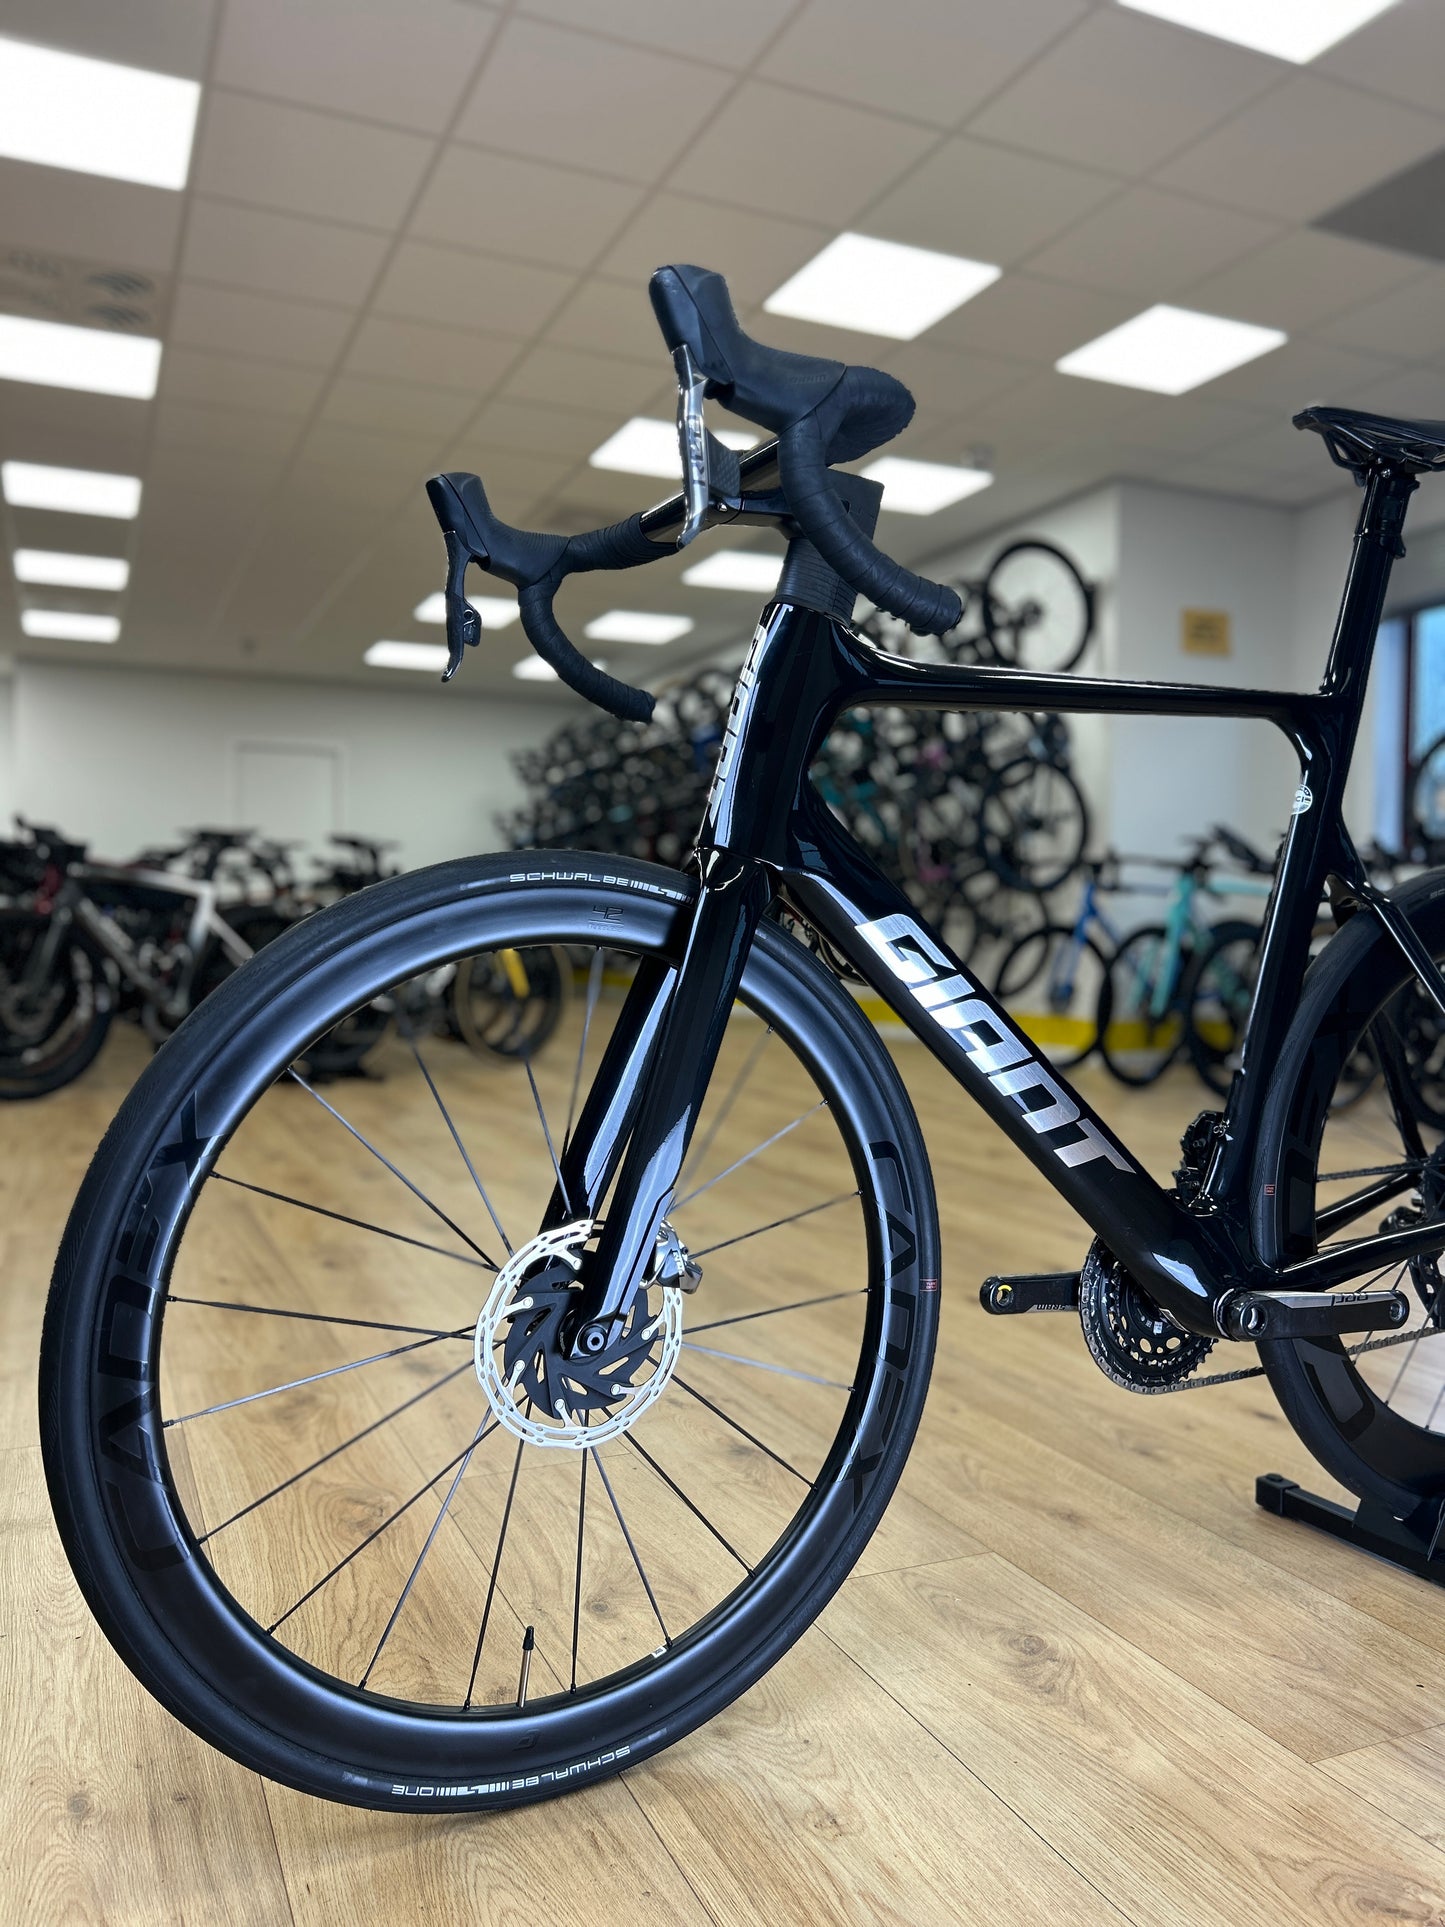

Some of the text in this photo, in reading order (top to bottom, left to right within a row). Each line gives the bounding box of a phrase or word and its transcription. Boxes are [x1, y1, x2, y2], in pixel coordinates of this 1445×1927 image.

[509, 871, 629, 887] SCHWALBE
[854, 913, 1137, 1174] GIANT
[97, 1090, 231, 1572] CADEX
[831, 1141, 918, 1515] CADEX
[390, 1745, 631, 1797] SCHWALBE ONE
